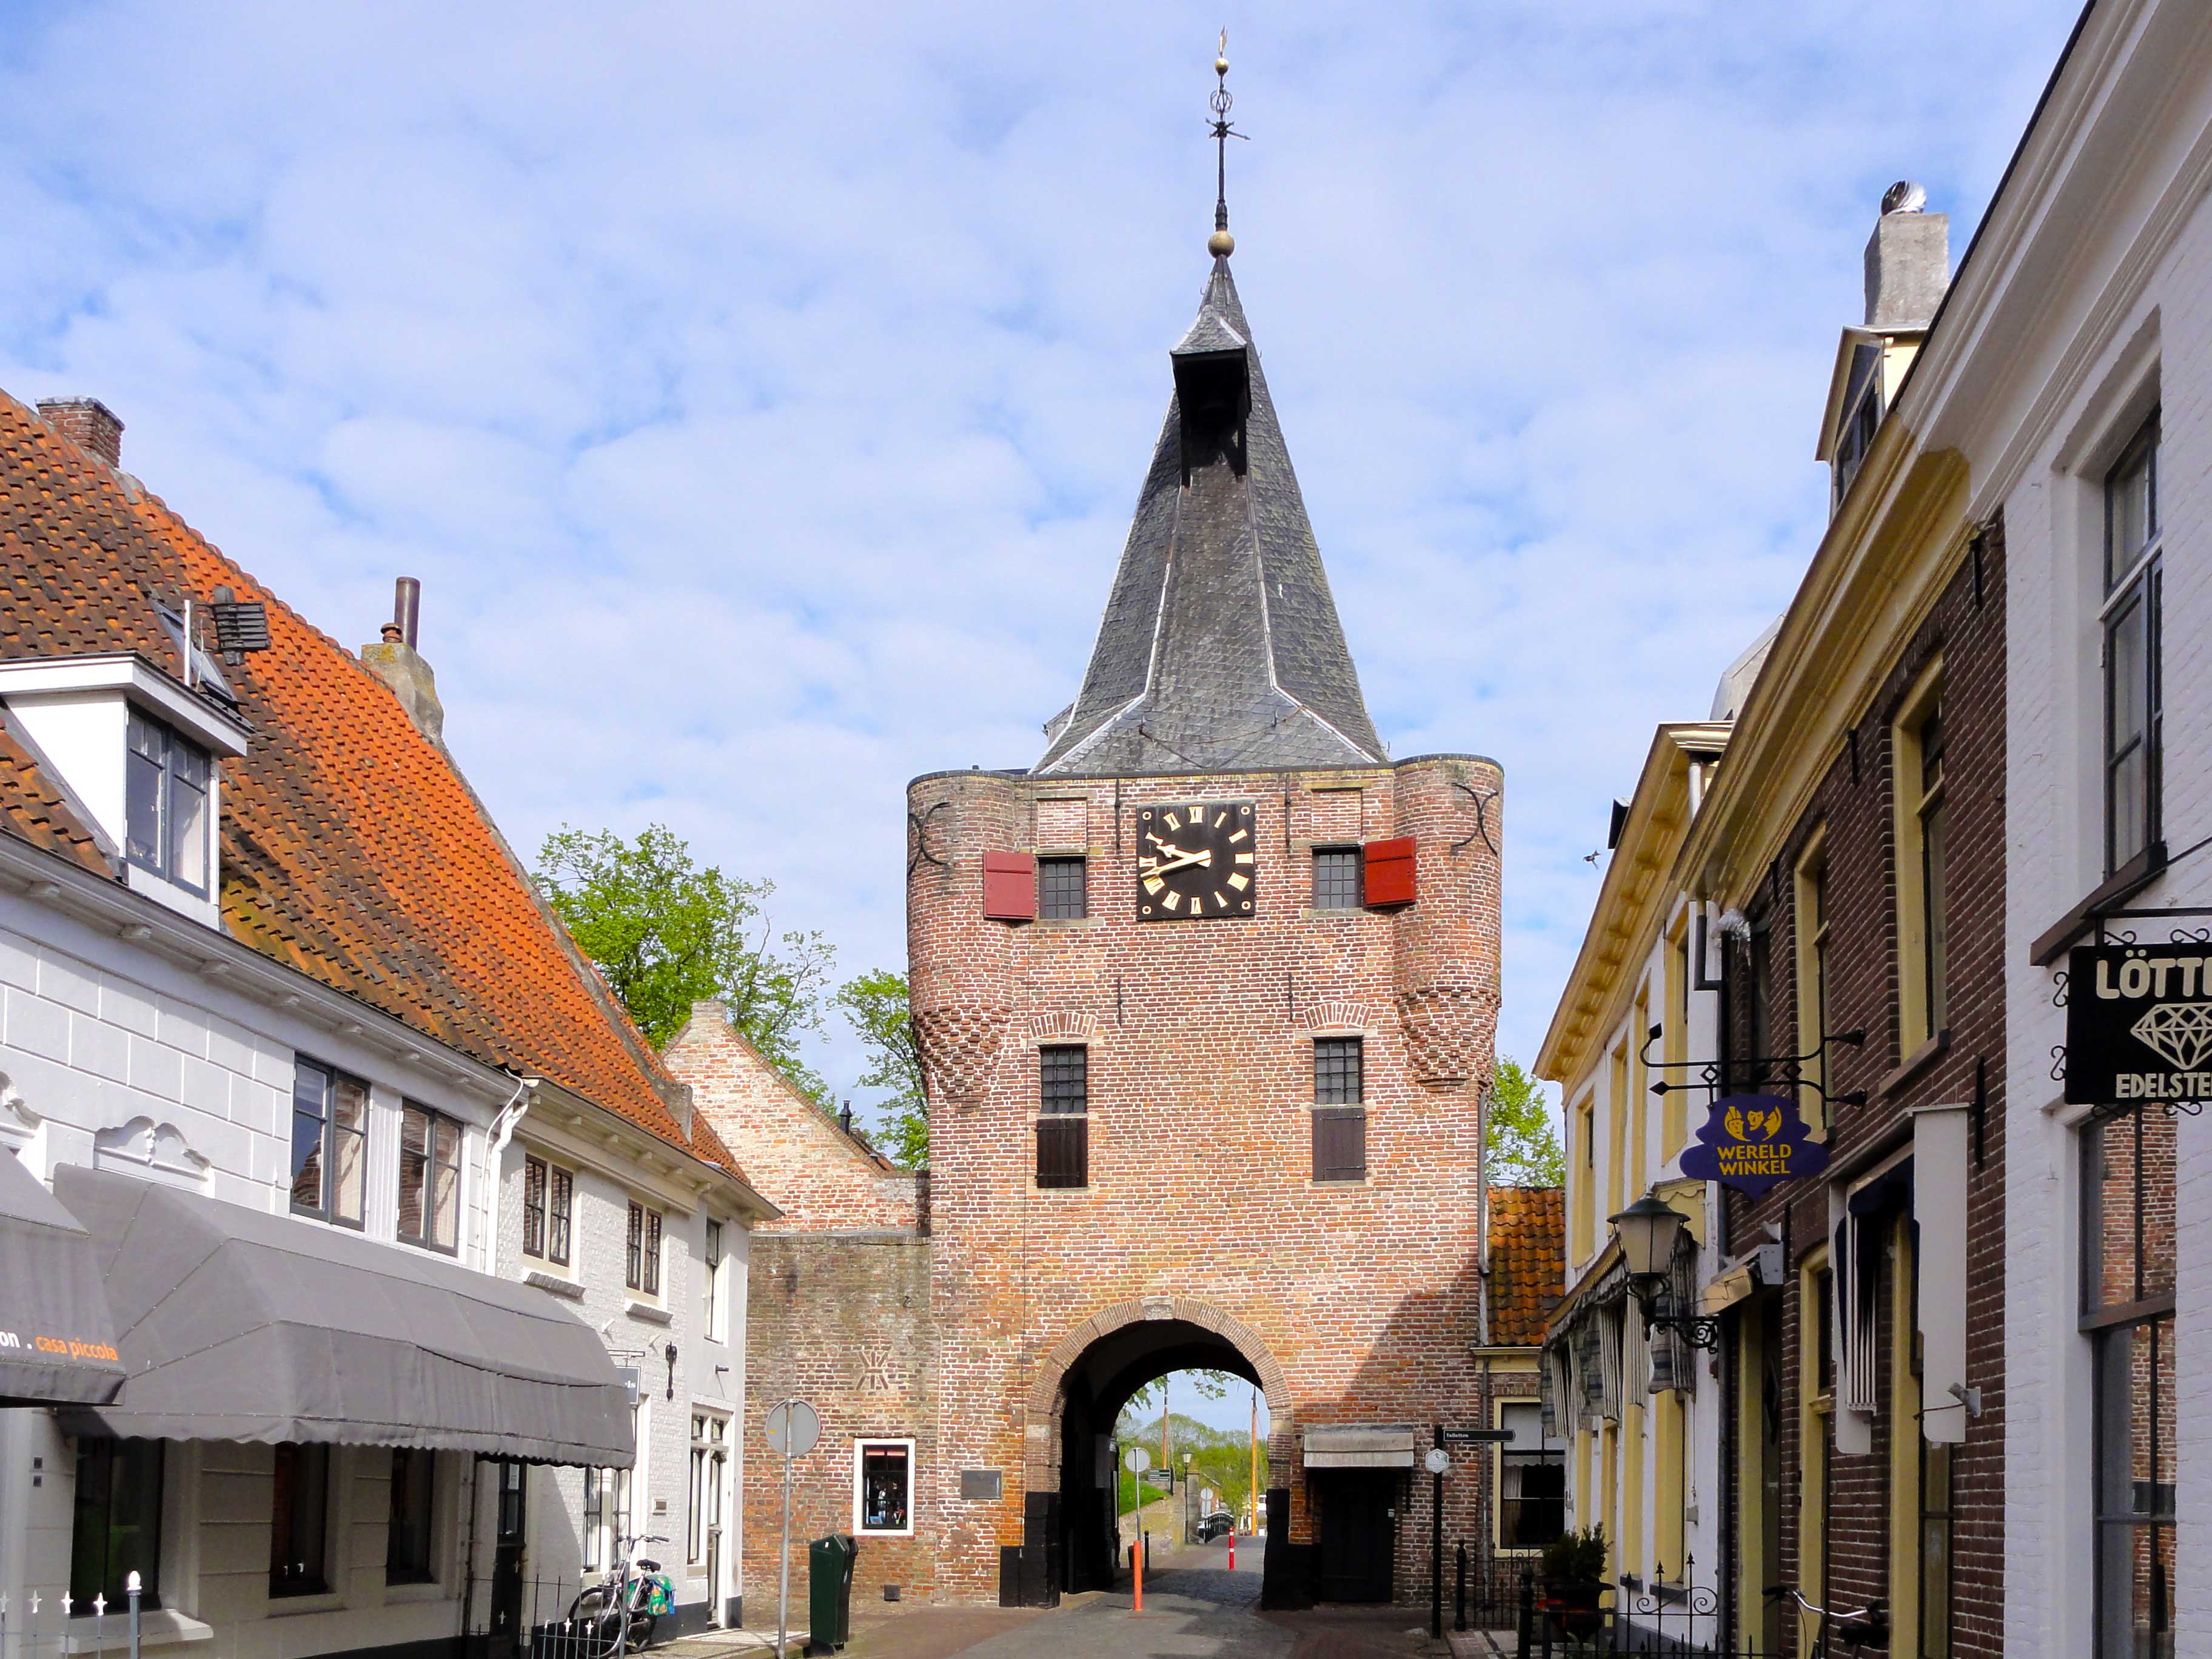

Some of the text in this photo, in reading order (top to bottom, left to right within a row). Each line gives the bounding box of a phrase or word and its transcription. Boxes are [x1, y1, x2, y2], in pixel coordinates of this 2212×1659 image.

[2116, 1072, 2212, 1098] EDELSTE
[1717, 1144, 1792, 1160] WERELD
[1718, 1160, 1791, 1176] WINKEL
[35, 1336, 67, 1354] casa
[68, 1337, 119, 1361] piccola
